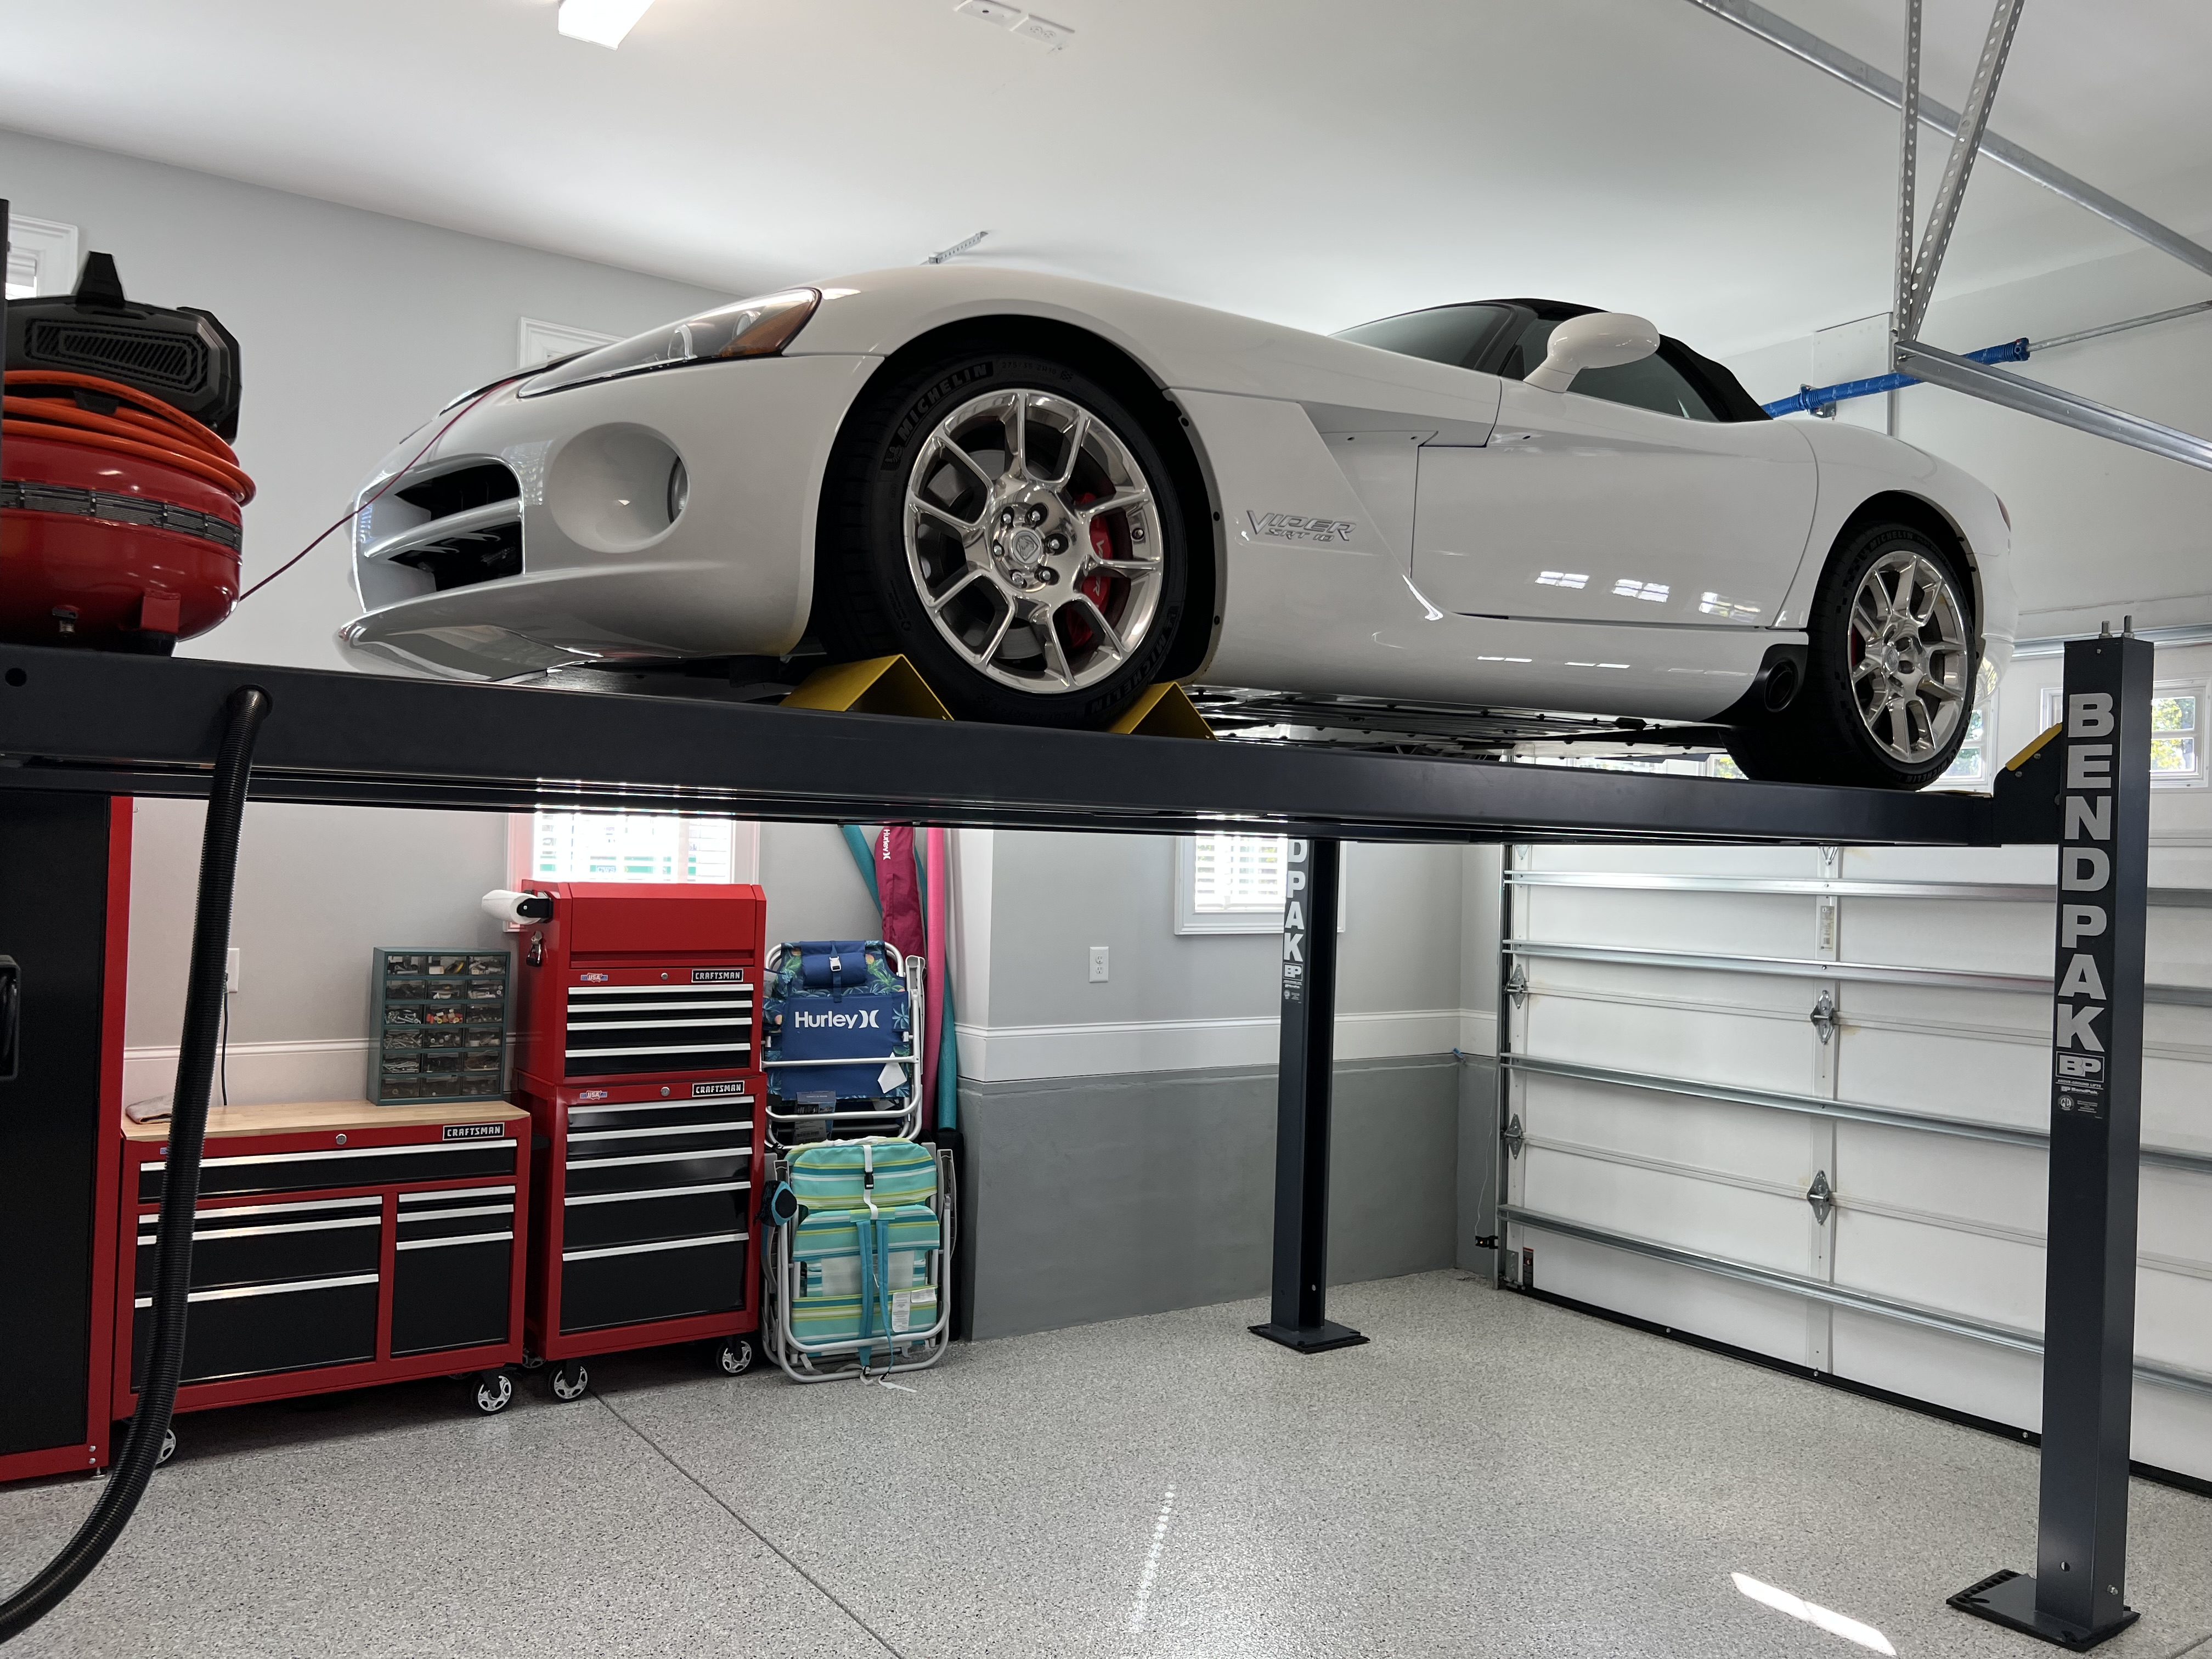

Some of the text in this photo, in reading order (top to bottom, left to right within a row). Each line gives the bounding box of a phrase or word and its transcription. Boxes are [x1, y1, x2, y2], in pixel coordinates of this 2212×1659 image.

[896, 364, 988, 441] MICHELIN
[1246, 510, 1357, 541] VIPER
[1265, 528, 1335, 542] SRT 10
[1869, 531, 1913, 550] MICHELIN
[1091, 635, 1167, 713] MICHELIN
[2057, 692, 2114, 1052] BENDPAK
[695, 971, 741, 980] CRAFTSMAN
[1284, 964, 1302, 978] BP
[795, 1009, 859, 1029] Hurley
[2059, 1054, 2102, 1077] BP
[696, 1084, 742, 1093] CRAFTSMAN
[447, 1126, 501, 1137] CRAFTSMAN
